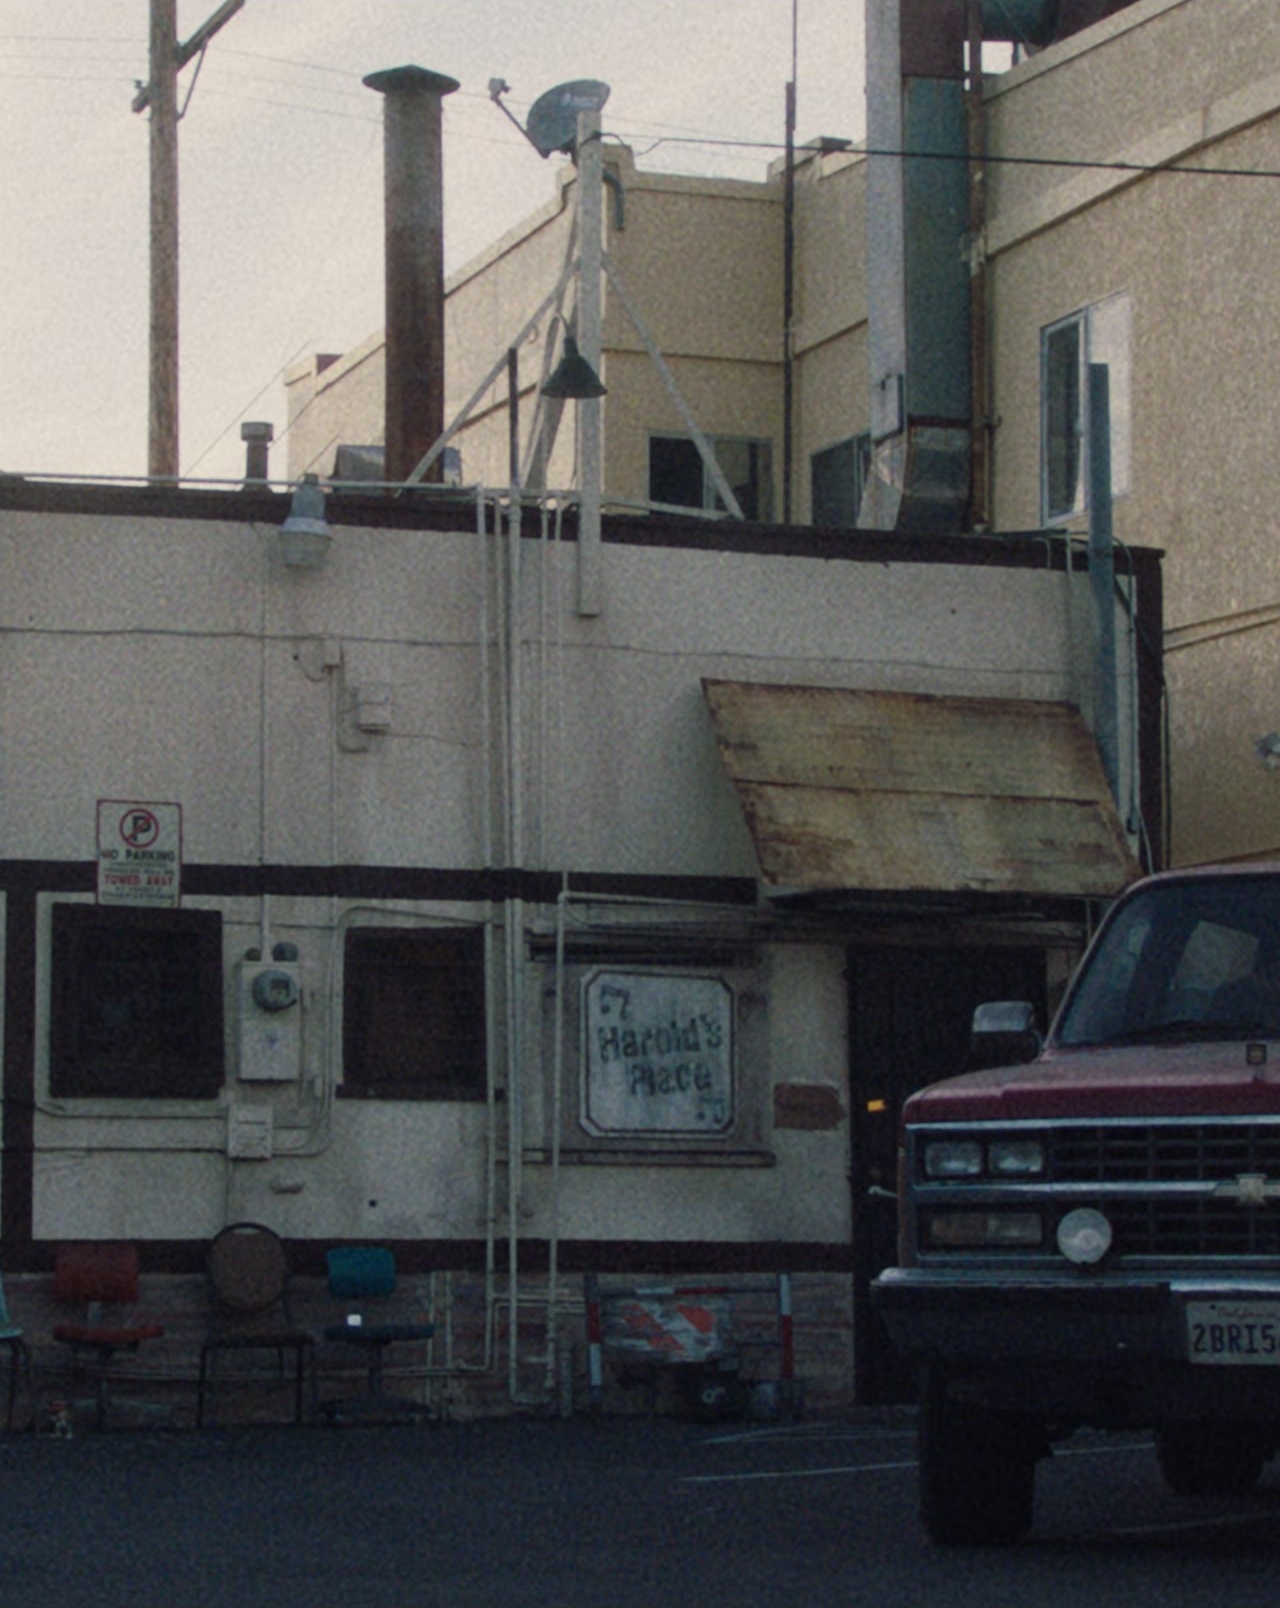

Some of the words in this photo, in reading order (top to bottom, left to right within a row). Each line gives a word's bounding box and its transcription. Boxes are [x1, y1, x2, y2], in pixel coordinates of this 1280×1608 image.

[101, 849, 119, 860] NO
[125, 850, 175, 861] PARKING
[104, 874, 140, 885] TOWED
[146, 875, 174, 886] AWAY
[597, 1014, 724, 1063] Harold's
[631, 1063, 713, 1096] Place
